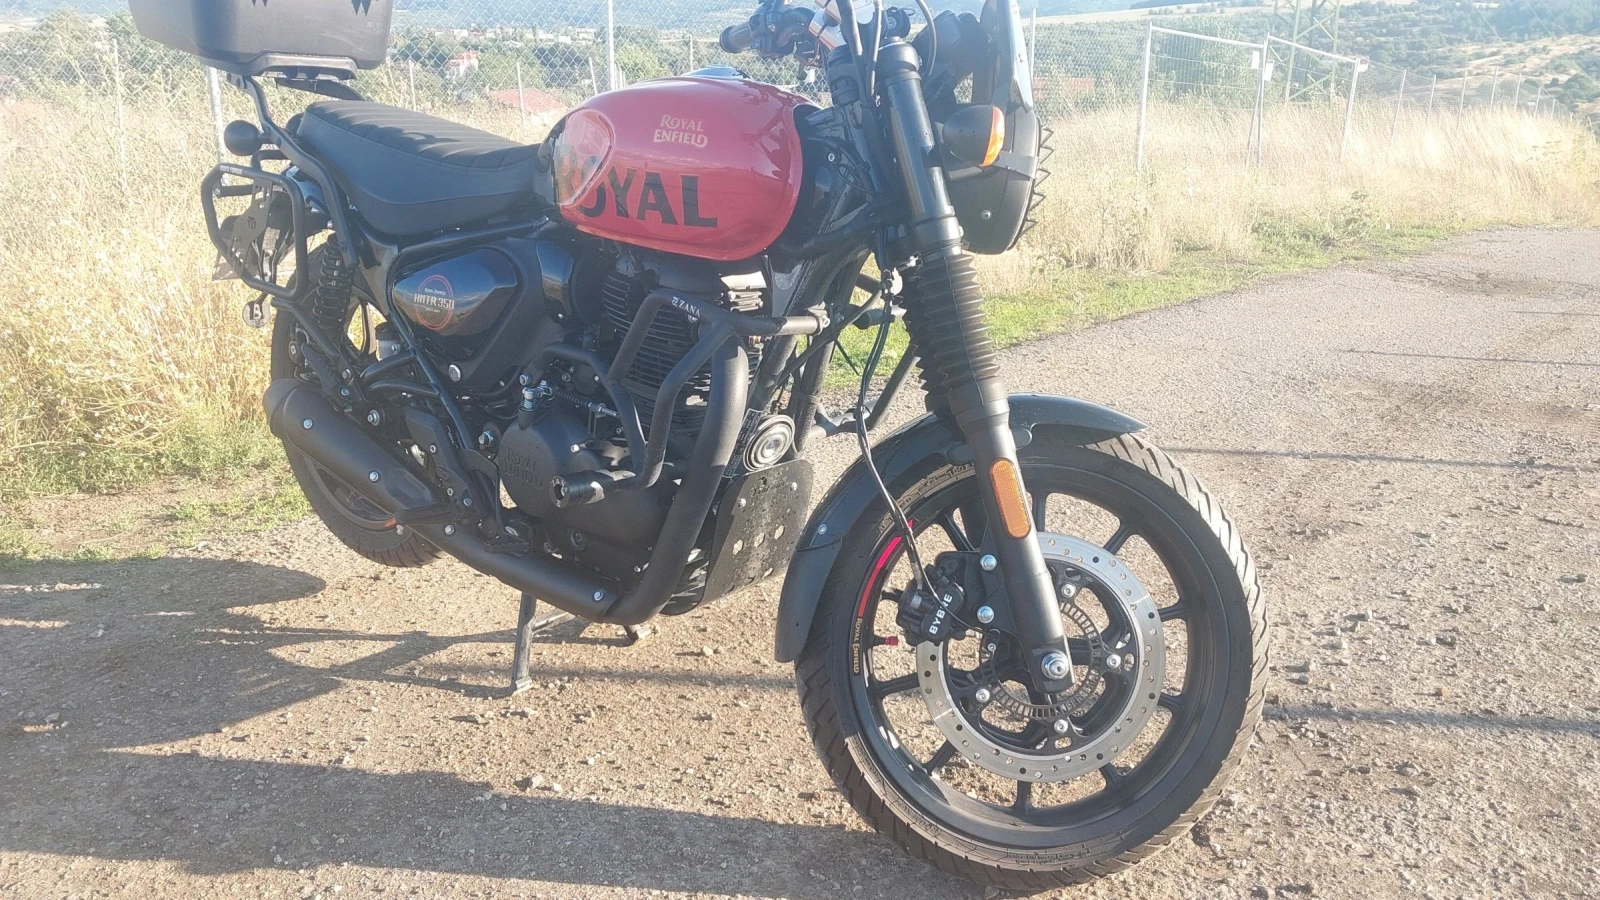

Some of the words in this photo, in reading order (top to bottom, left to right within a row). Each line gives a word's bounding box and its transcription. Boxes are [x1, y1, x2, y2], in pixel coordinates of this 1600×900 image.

[660, 114, 704, 131] ROYAL
[653, 129, 708, 148] ENFIELD
[853, 617, 863, 642] ROYAL
[852, 643, 860, 674] ENFIELD
